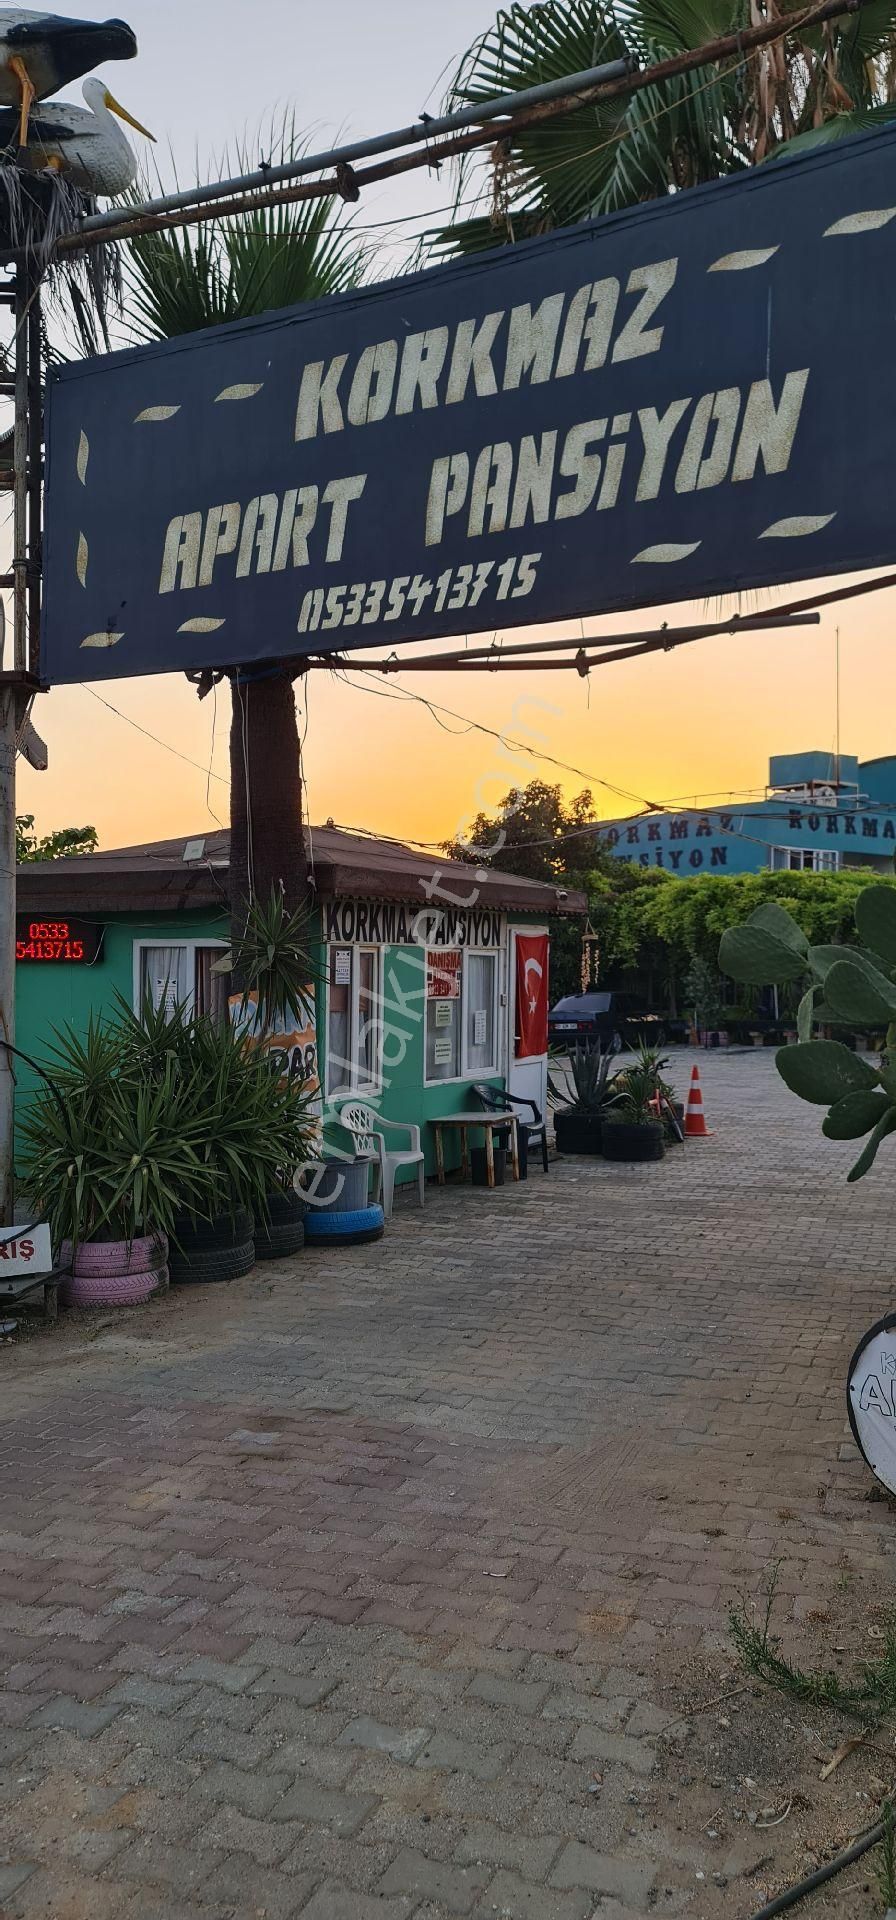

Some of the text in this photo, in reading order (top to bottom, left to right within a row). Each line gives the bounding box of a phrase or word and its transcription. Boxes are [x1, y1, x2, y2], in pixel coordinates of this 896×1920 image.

[294, 257, 679, 441] KORKMAZ
[158, 473, 366, 594] APART
[594, 815, 735, 845] ORKMAZ
[29, 922, 70, 940] 0533
[325, 902, 419, 943] KORKMAZ
[16, 941, 84, 960] 5413715
[859, 1374, 896, 1417] A
